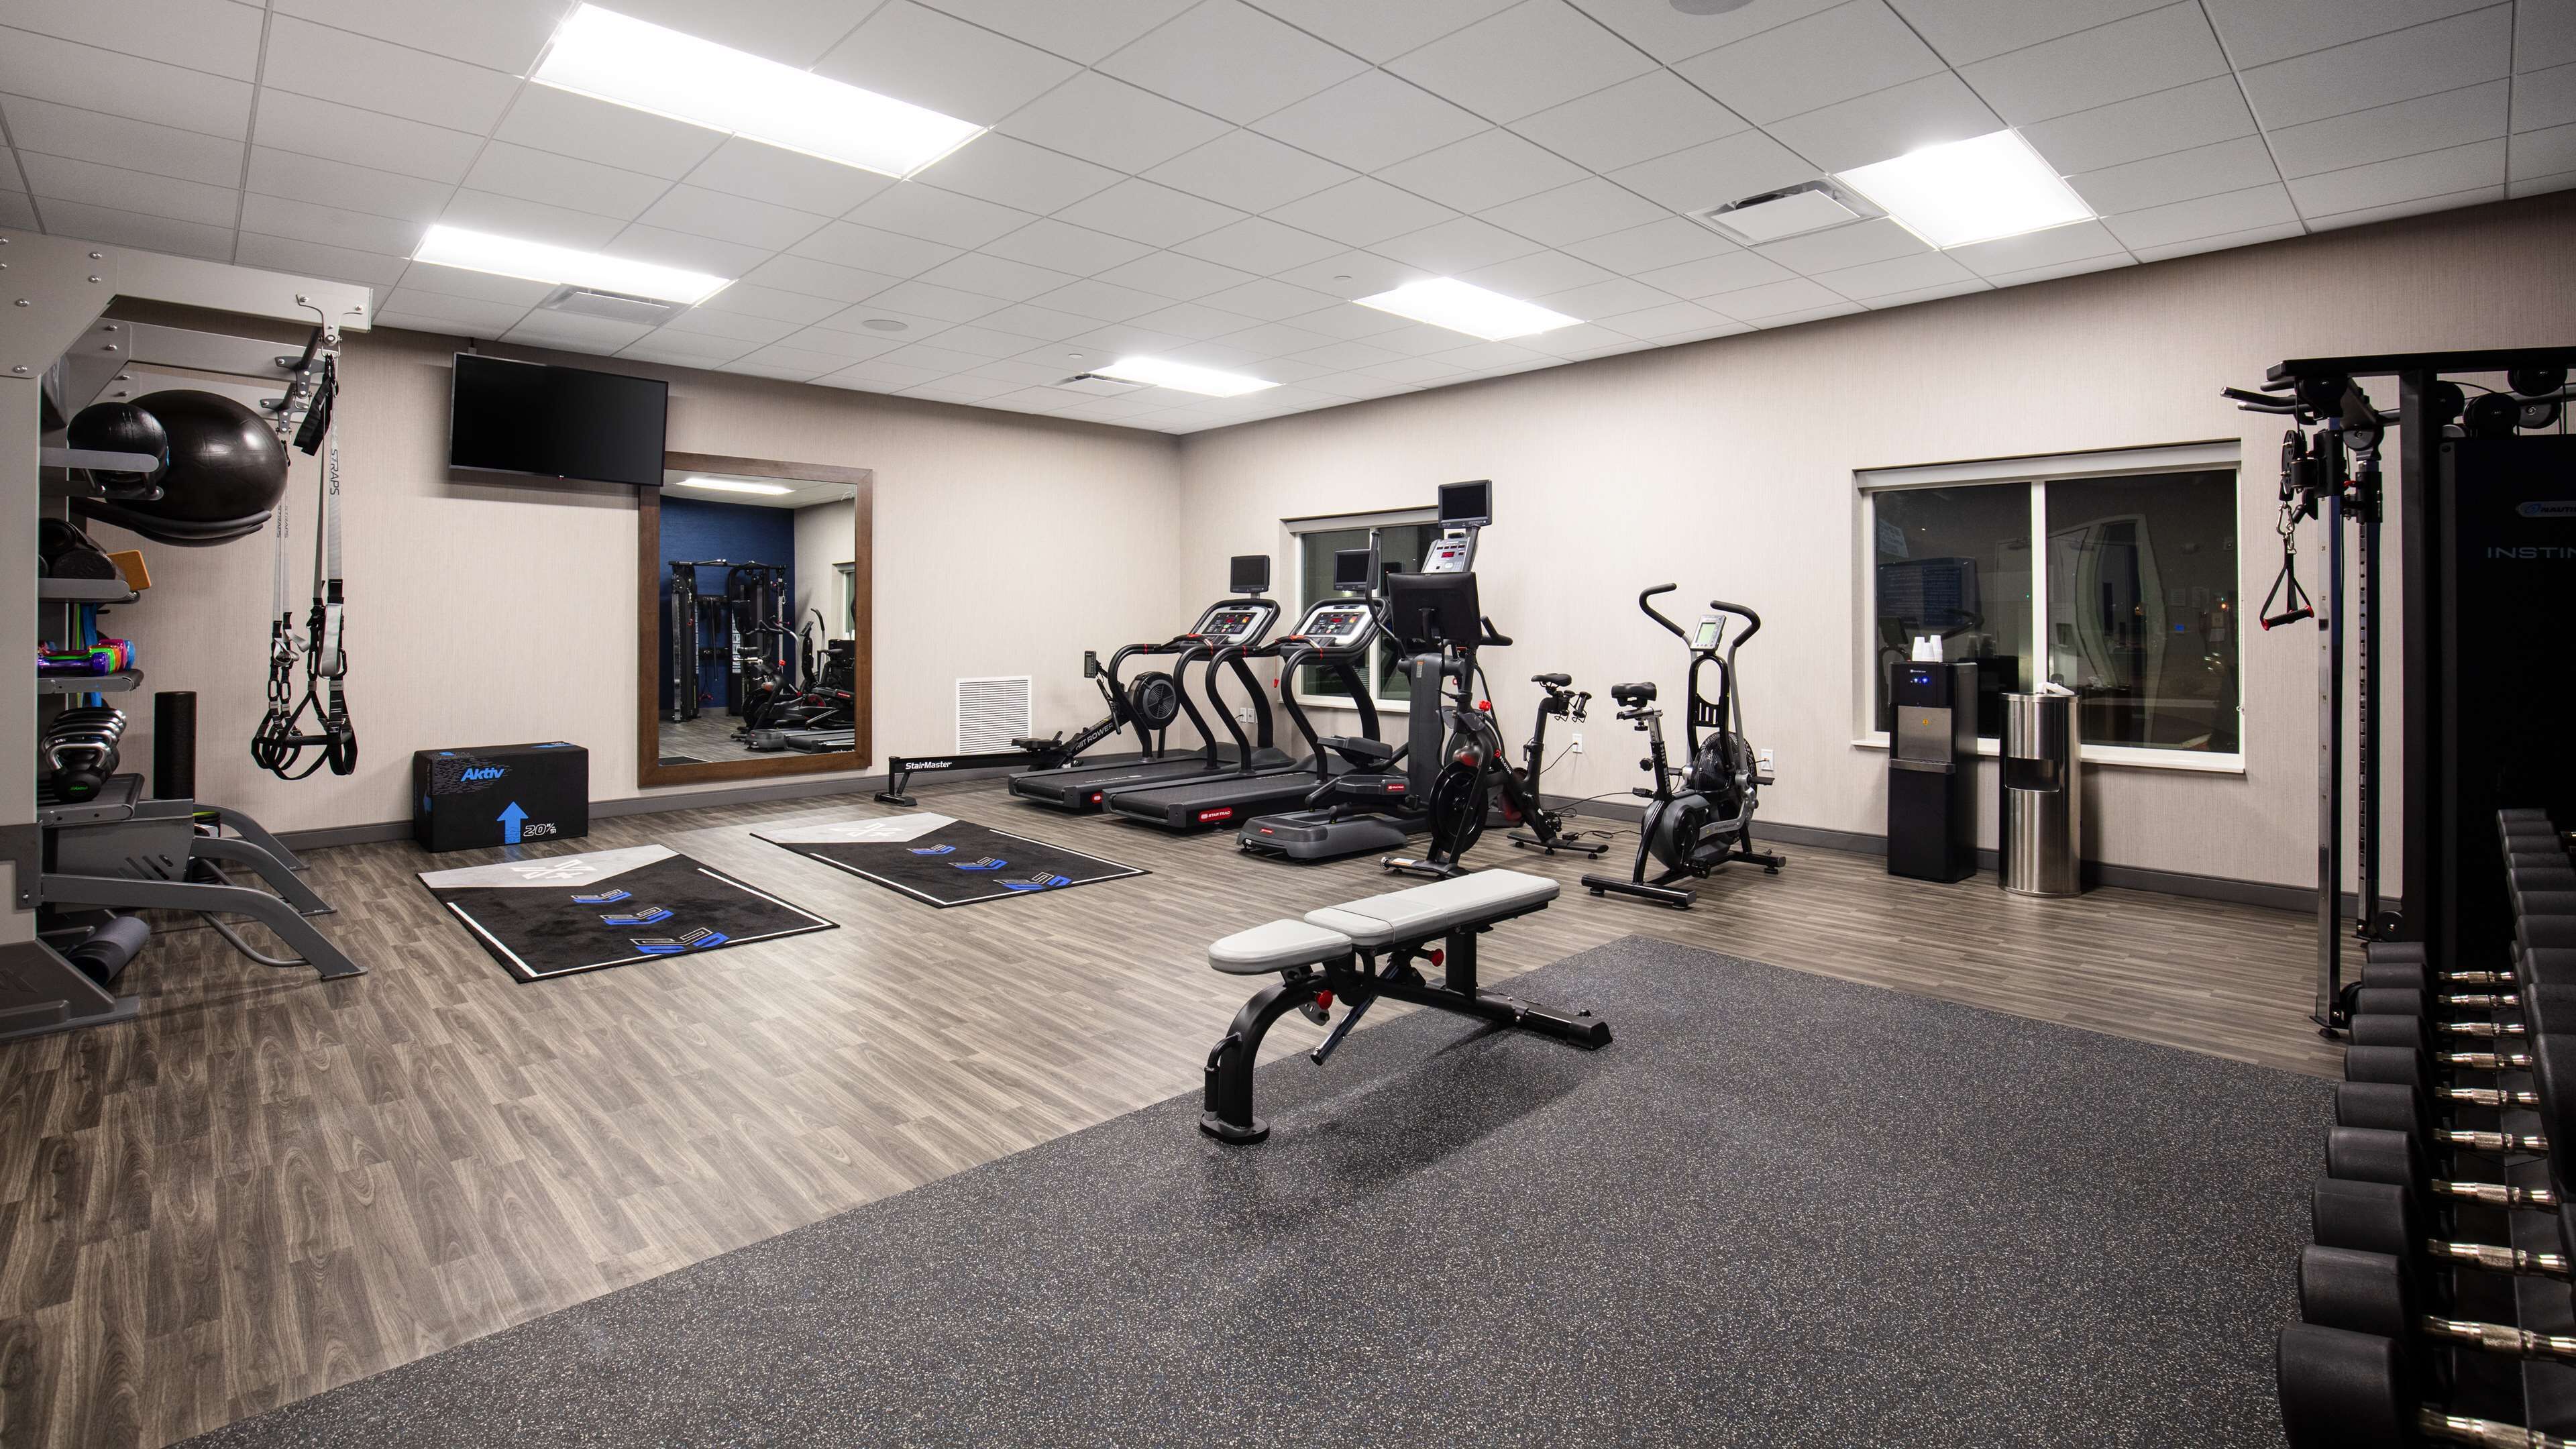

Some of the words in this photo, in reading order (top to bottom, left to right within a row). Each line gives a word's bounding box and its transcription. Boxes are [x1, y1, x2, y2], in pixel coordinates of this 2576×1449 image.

[329, 449, 340, 496] STRAPS
[905, 761, 952, 770] StairMaster
[1499, 755, 1512, 775] PELOTON
[460, 767, 504, 782] Aktiv
